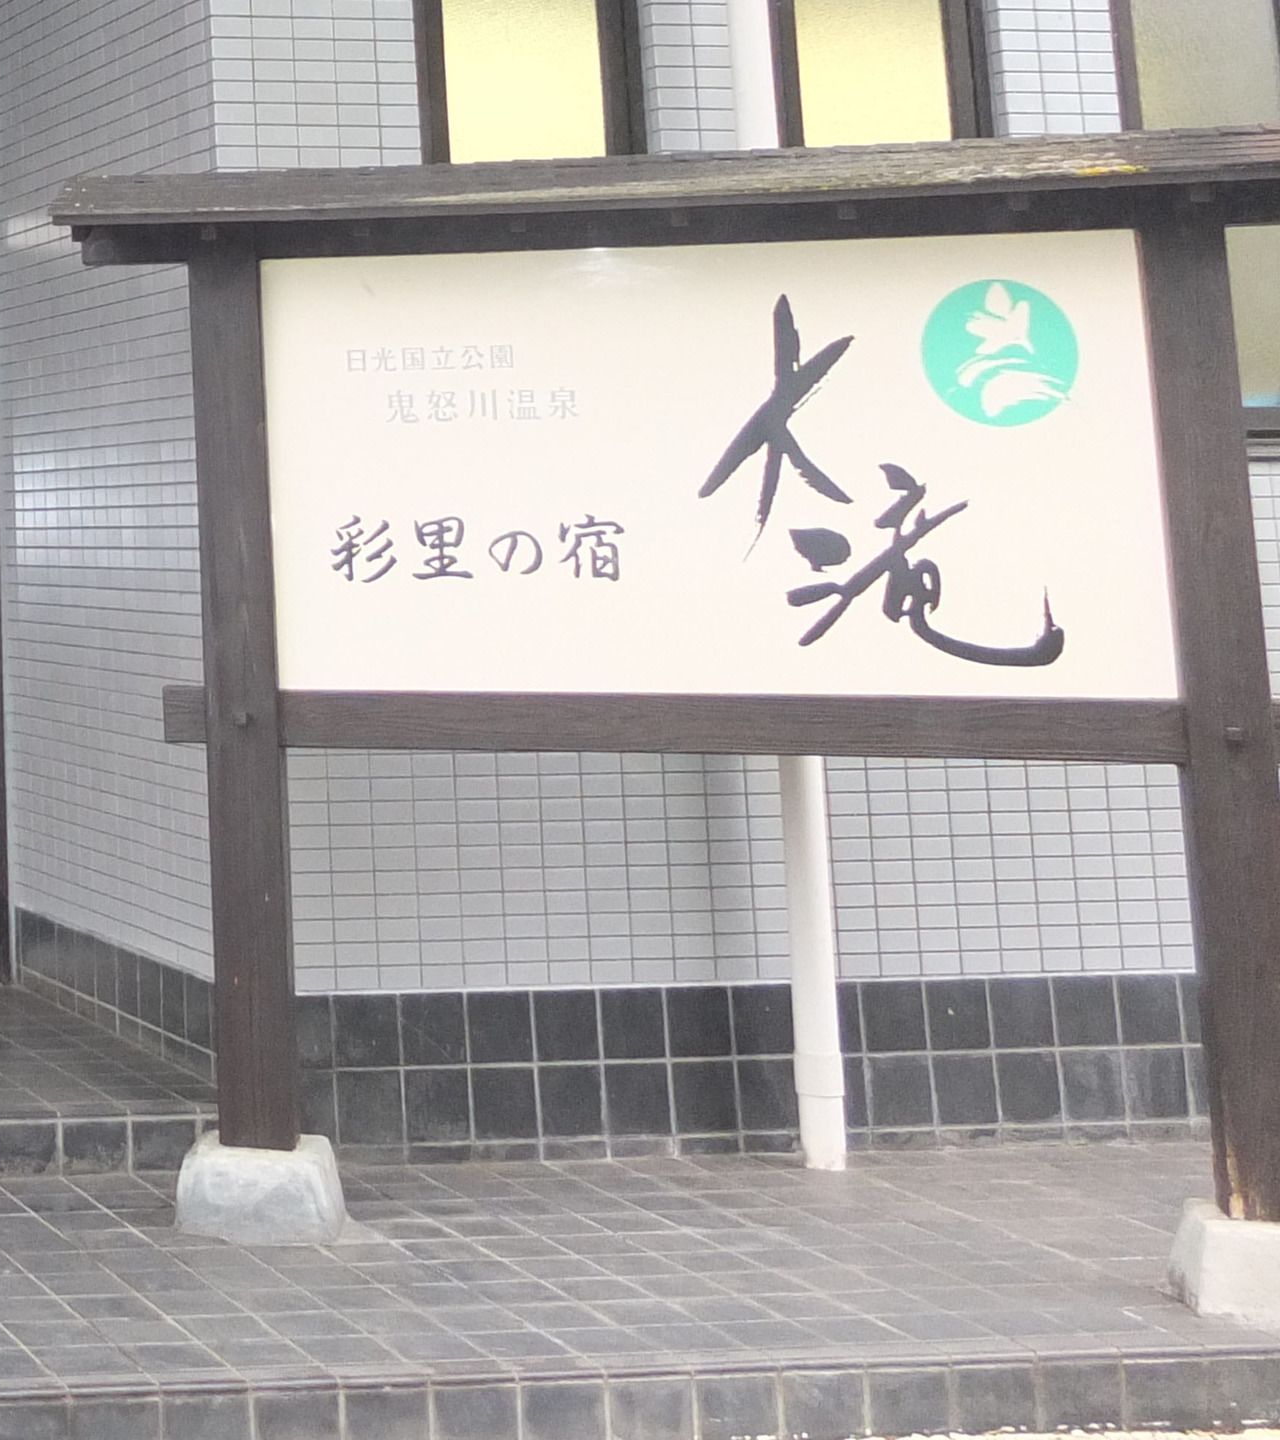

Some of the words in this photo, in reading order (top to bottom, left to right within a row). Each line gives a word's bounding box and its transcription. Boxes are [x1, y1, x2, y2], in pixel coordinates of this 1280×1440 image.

[345, 343, 515, 373] 日光国立公園
[385, 387, 580, 424] 鬼怒川温泉
[697, 291, 1066, 668] 大滝
[330, 513, 625, 584] 彩里の宿
